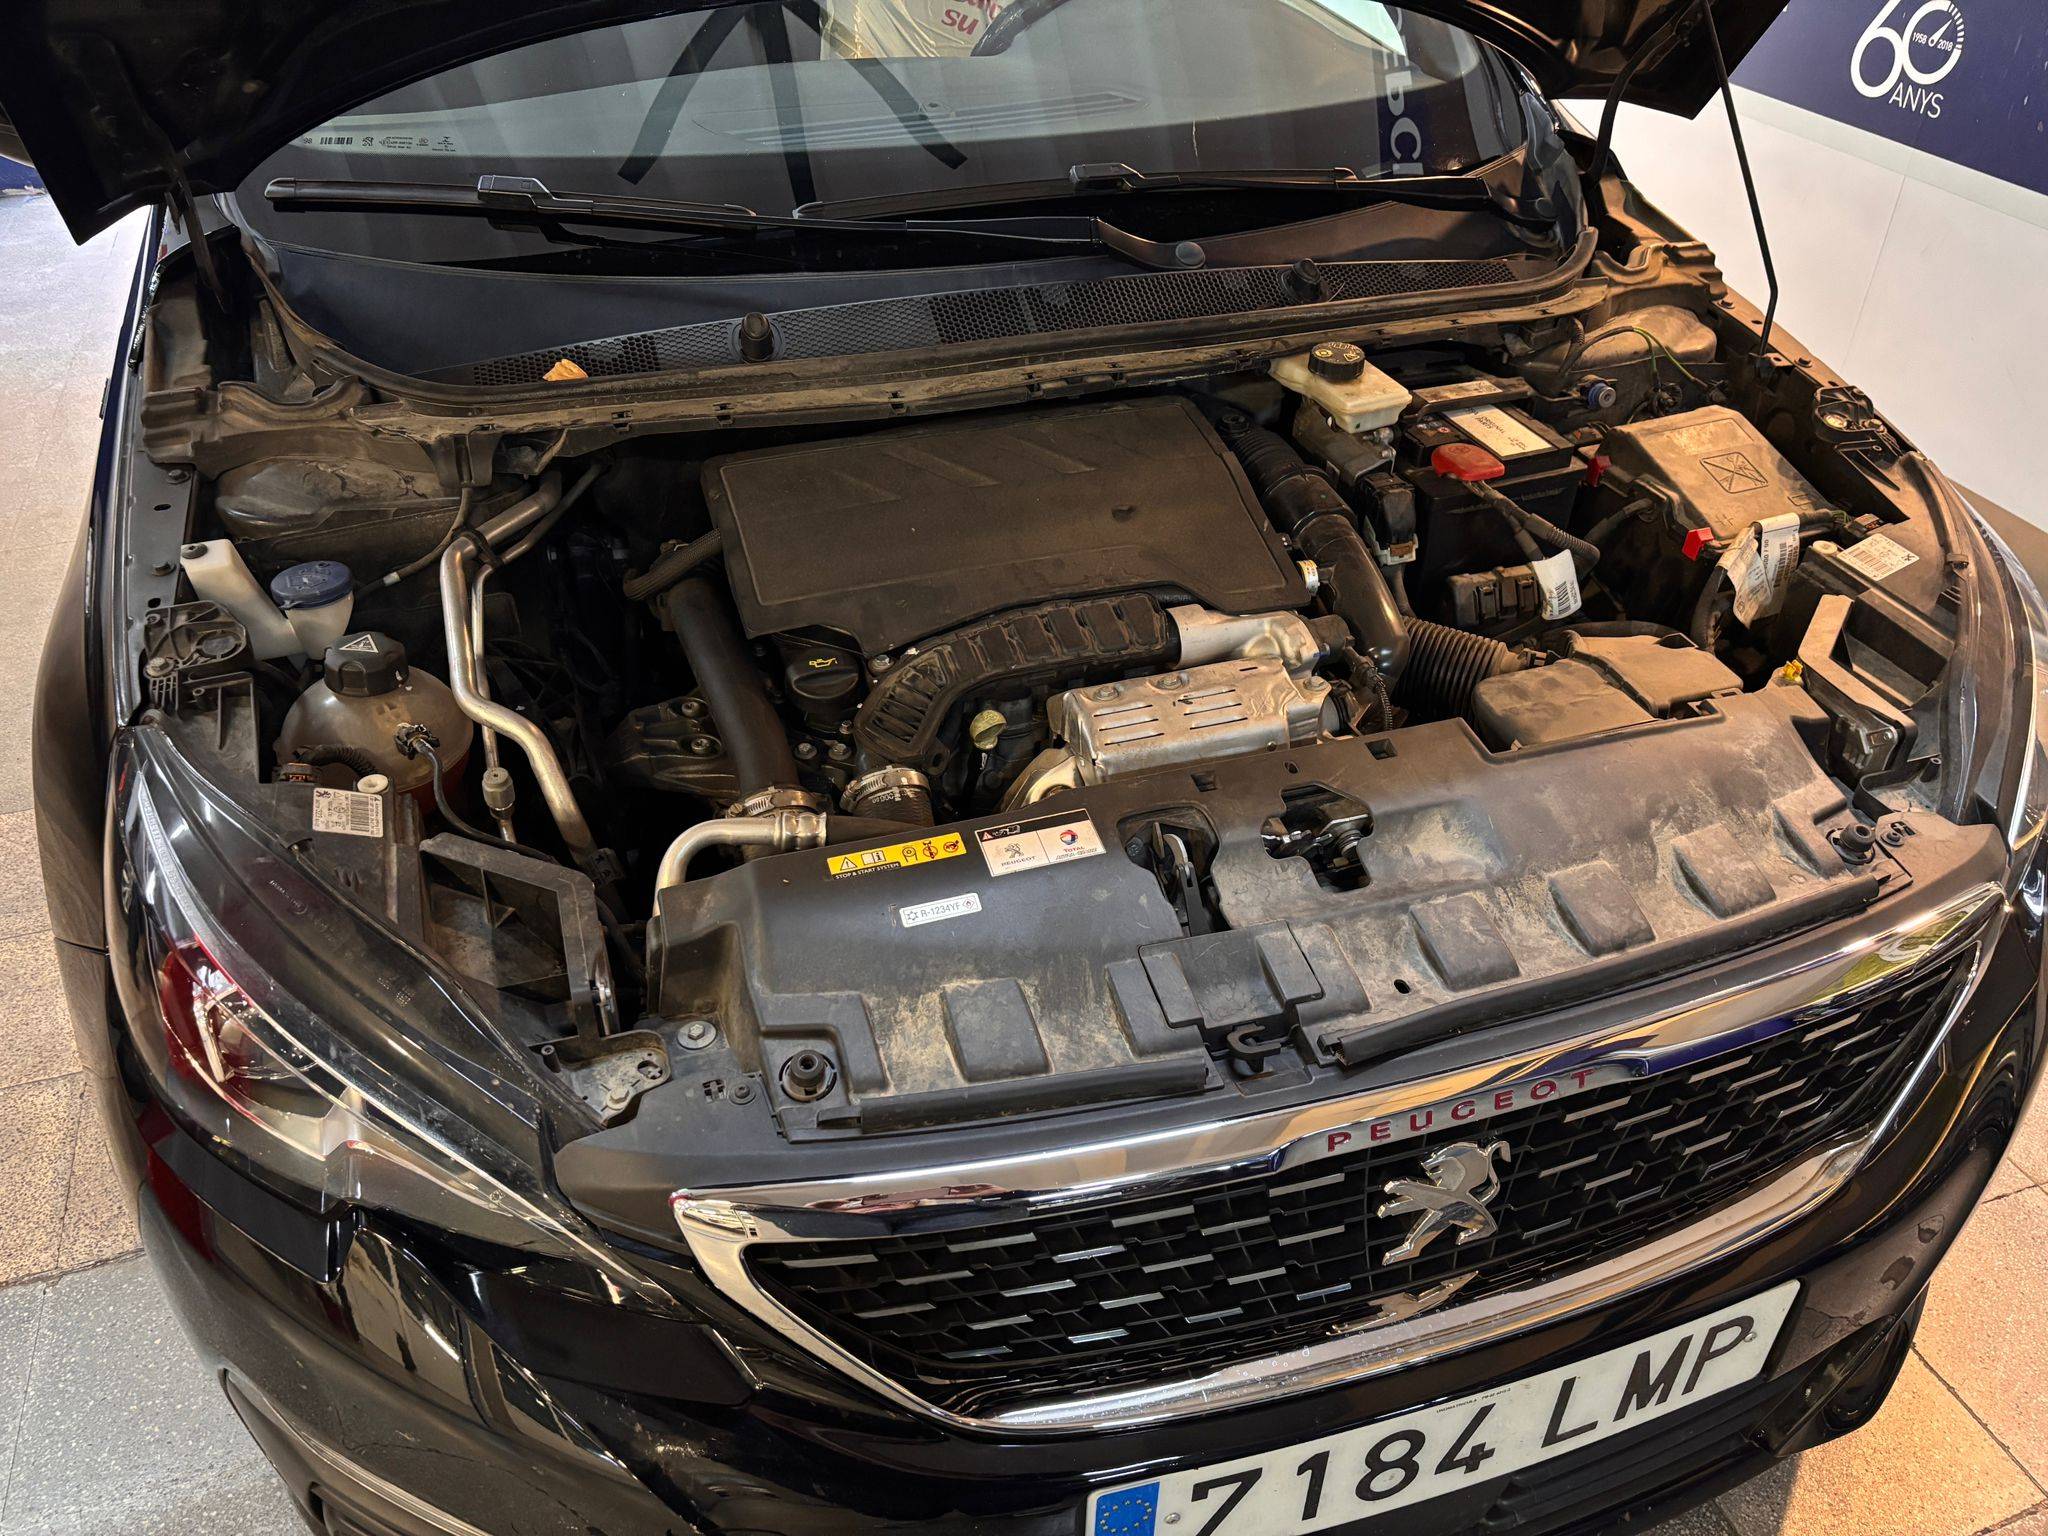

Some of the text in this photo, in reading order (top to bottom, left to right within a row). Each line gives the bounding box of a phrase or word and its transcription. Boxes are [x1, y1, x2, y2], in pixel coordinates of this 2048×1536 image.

[1912, 32, 1954, 52] 1958 2018
[1888, 82, 1944, 119] ANYS
[920, 902, 961, 918] R-1234YF
[1326, 1069, 1597, 1153] PEUGEOT
[1190, 1315, 1756, 1536] 7184 LMP
